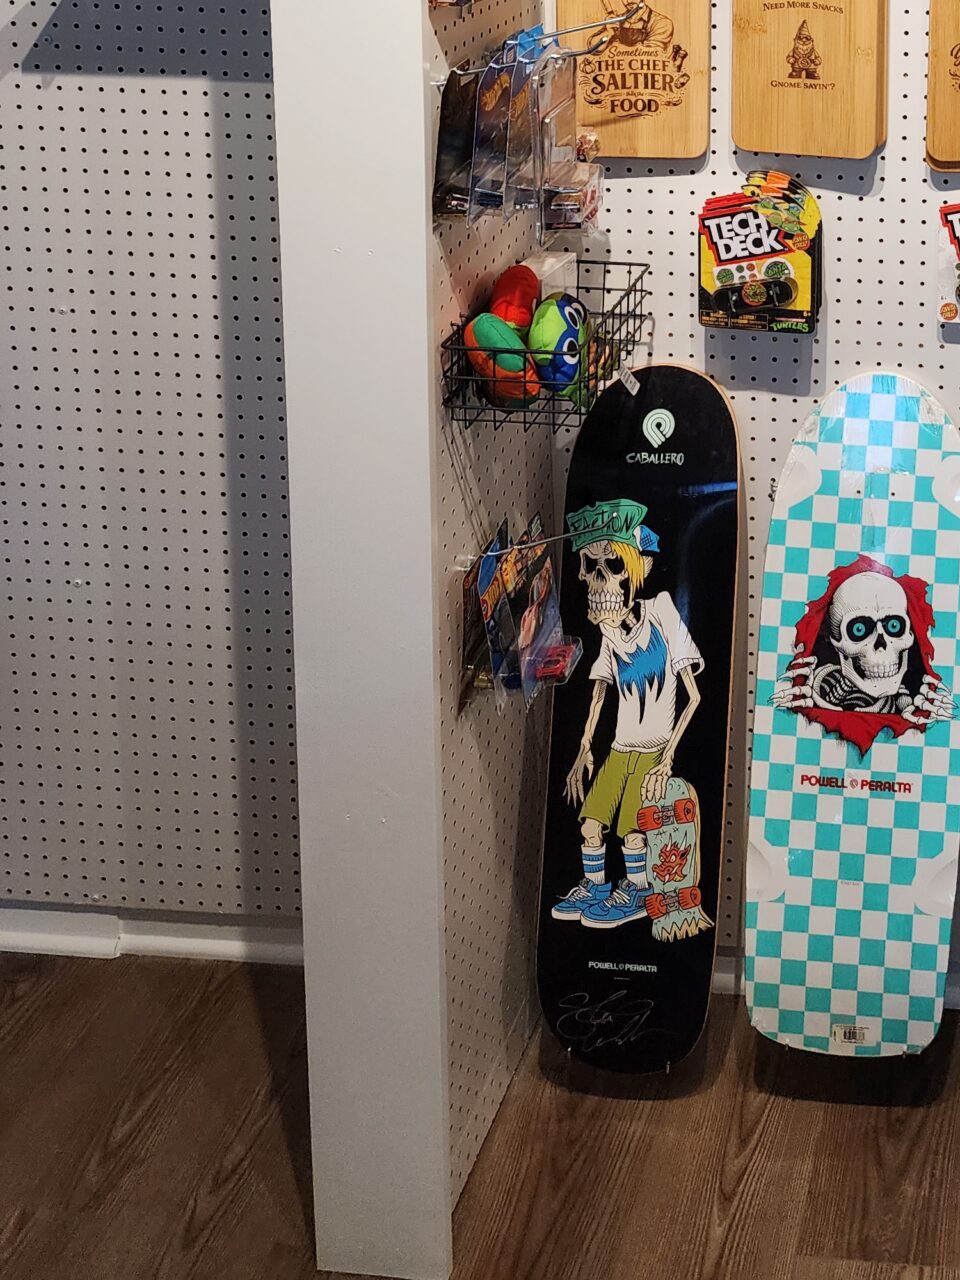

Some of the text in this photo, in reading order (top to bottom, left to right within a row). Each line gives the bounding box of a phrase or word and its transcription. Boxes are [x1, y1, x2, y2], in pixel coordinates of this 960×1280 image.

[763, 1, 844, 14] NEED MORE SNACKS
[608, 46, 659, 59] Sometimes
[596, 59, 671, 72] THE CHEF
[591, 73, 675, 95] SALTIER
[770, 80, 802, 89] GNOME
[610, 98, 660, 113] FOOD
[704, 212, 769, 243] TECH
[716, 228, 784, 261] DECK
[770, 322, 809, 333] TURTLES
[626, 452, 685, 466] CABALLERO
[800, 775, 912, 794] POWELL PERALTA
[589, 961, 658, 973] POWELL PERALTA
